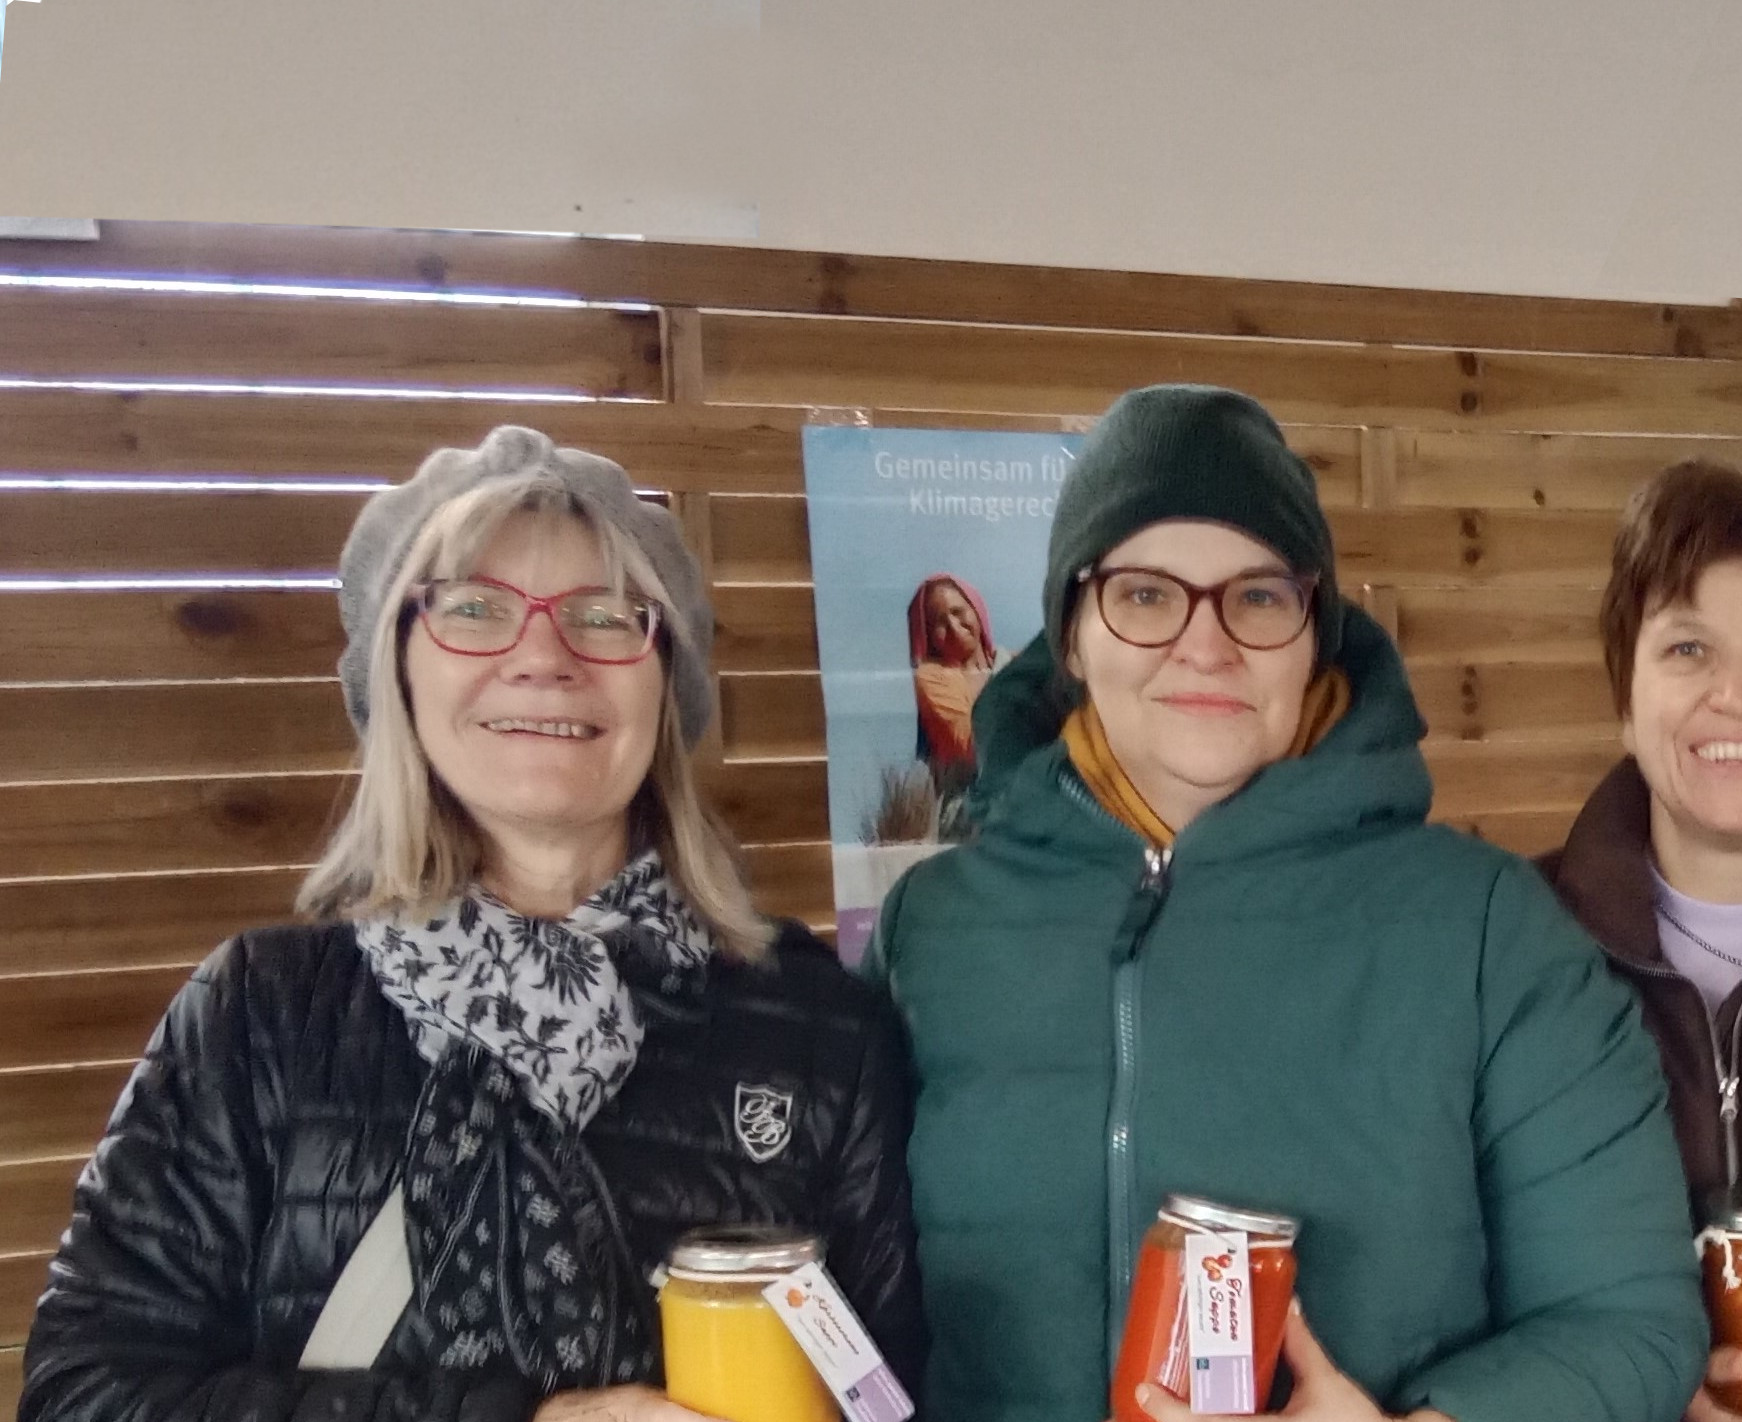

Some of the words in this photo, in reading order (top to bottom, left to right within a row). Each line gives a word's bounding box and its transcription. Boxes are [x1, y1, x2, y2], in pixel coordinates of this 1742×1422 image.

[874, 449, 1033, 485] Gemeinsam
[1040, 451, 1067, 484] fü
[908, 487, 1061, 522] Klimagerec
